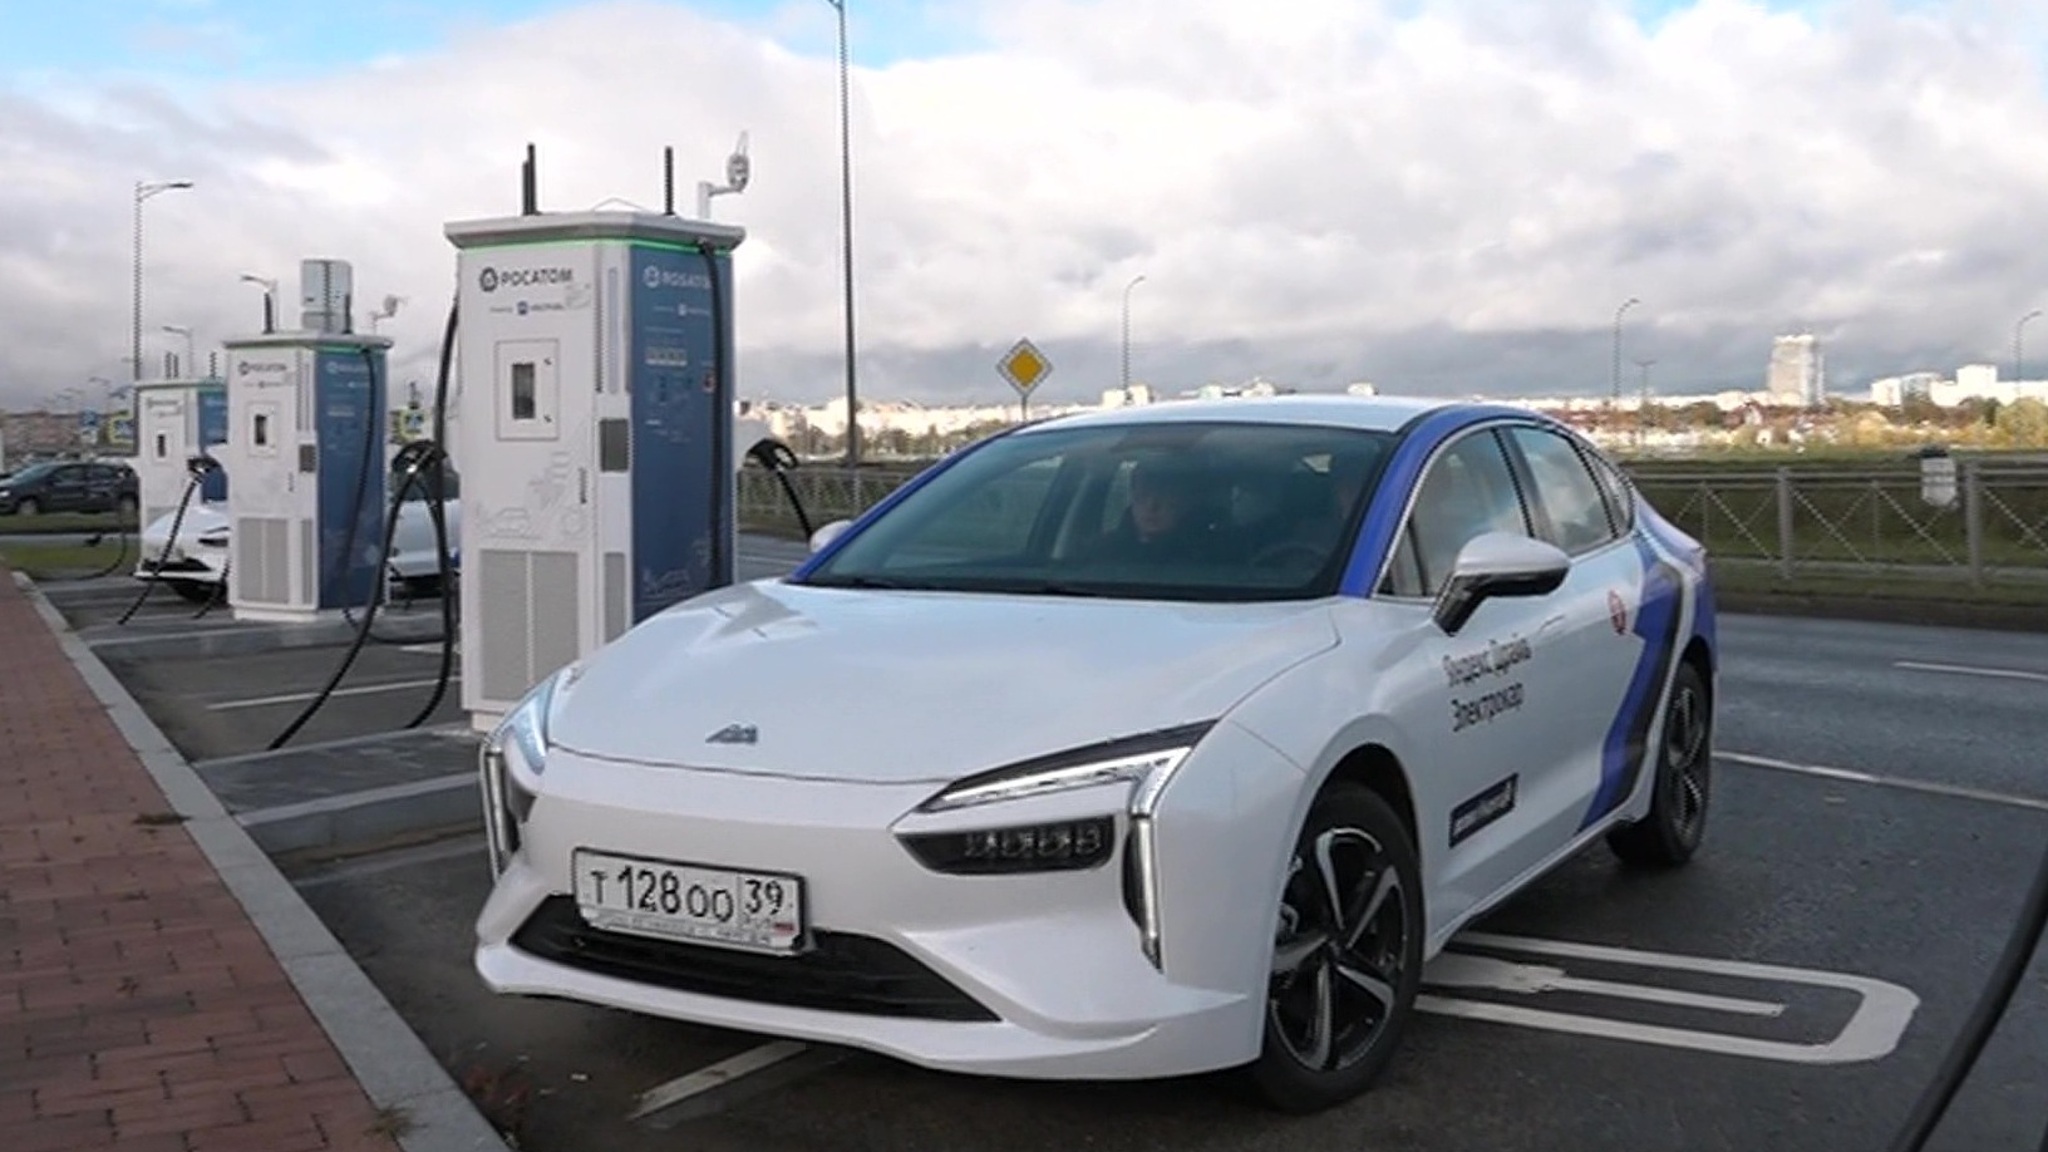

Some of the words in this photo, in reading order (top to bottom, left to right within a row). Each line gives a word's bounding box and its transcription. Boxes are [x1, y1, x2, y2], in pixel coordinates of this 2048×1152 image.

[500, 268, 573, 286] РОСАТОМ
[1443, 651, 1491, 687] Яндекс
[1451, 682, 1524, 733] Электрокар
[745, 878, 784, 916] 39
